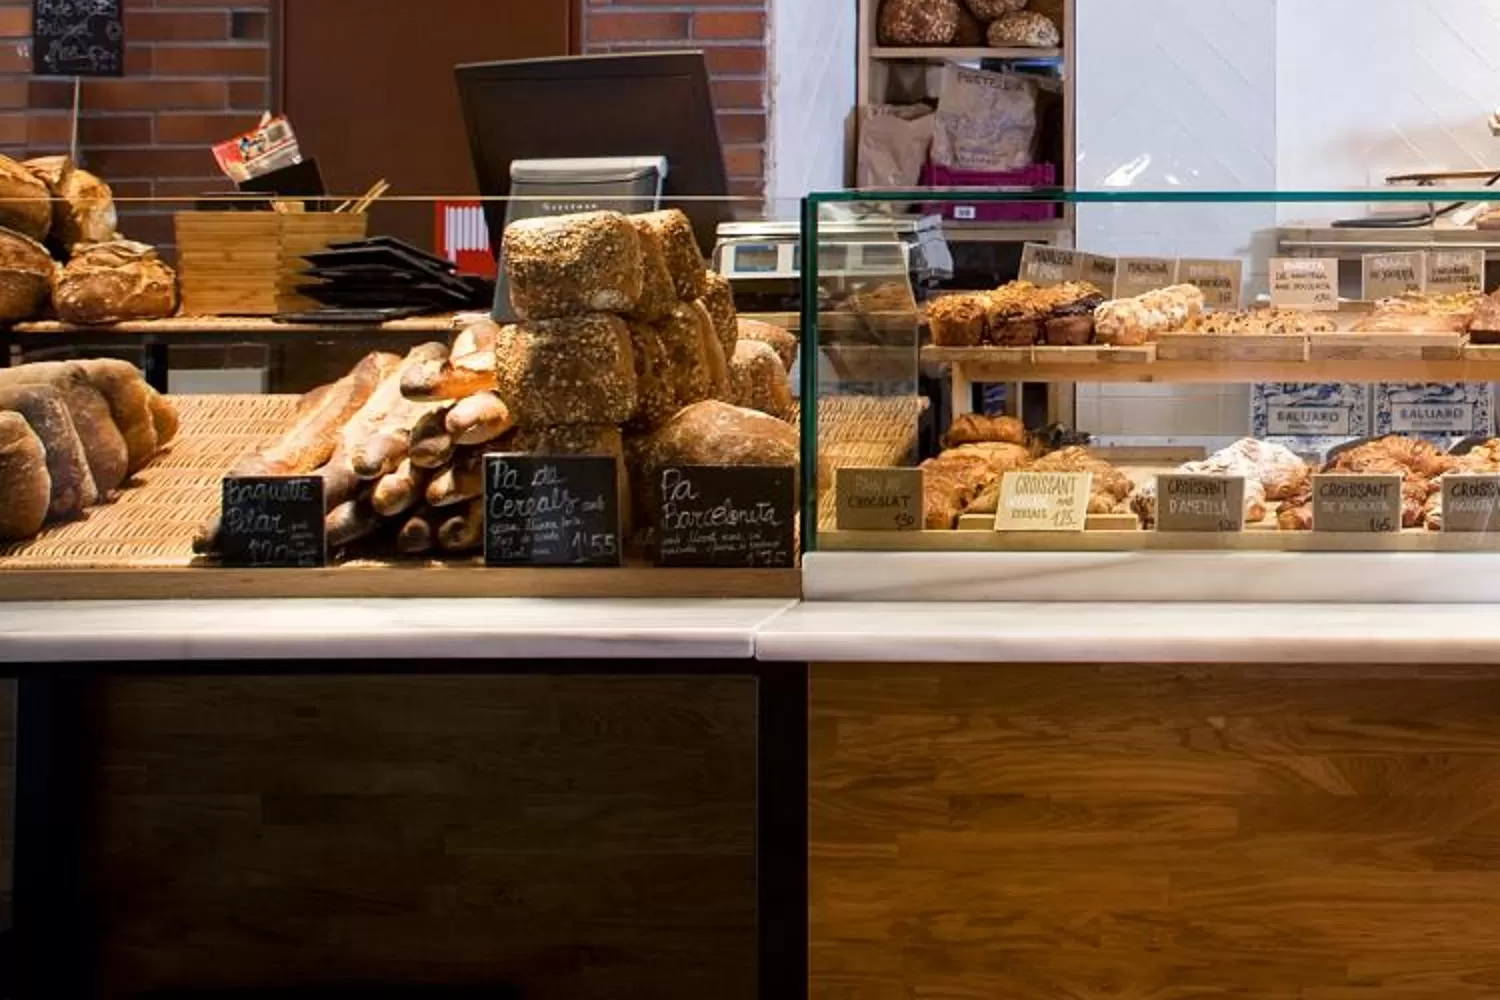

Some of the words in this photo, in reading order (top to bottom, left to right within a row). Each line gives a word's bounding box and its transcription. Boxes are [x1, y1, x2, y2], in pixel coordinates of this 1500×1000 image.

[489, 460, 523, 489] Pa
[661, 468, 699, 501] Pa
[1015, 475, 1079, 495] CROISSANT
[1320, 482, 1393, 499] CROISSANT
